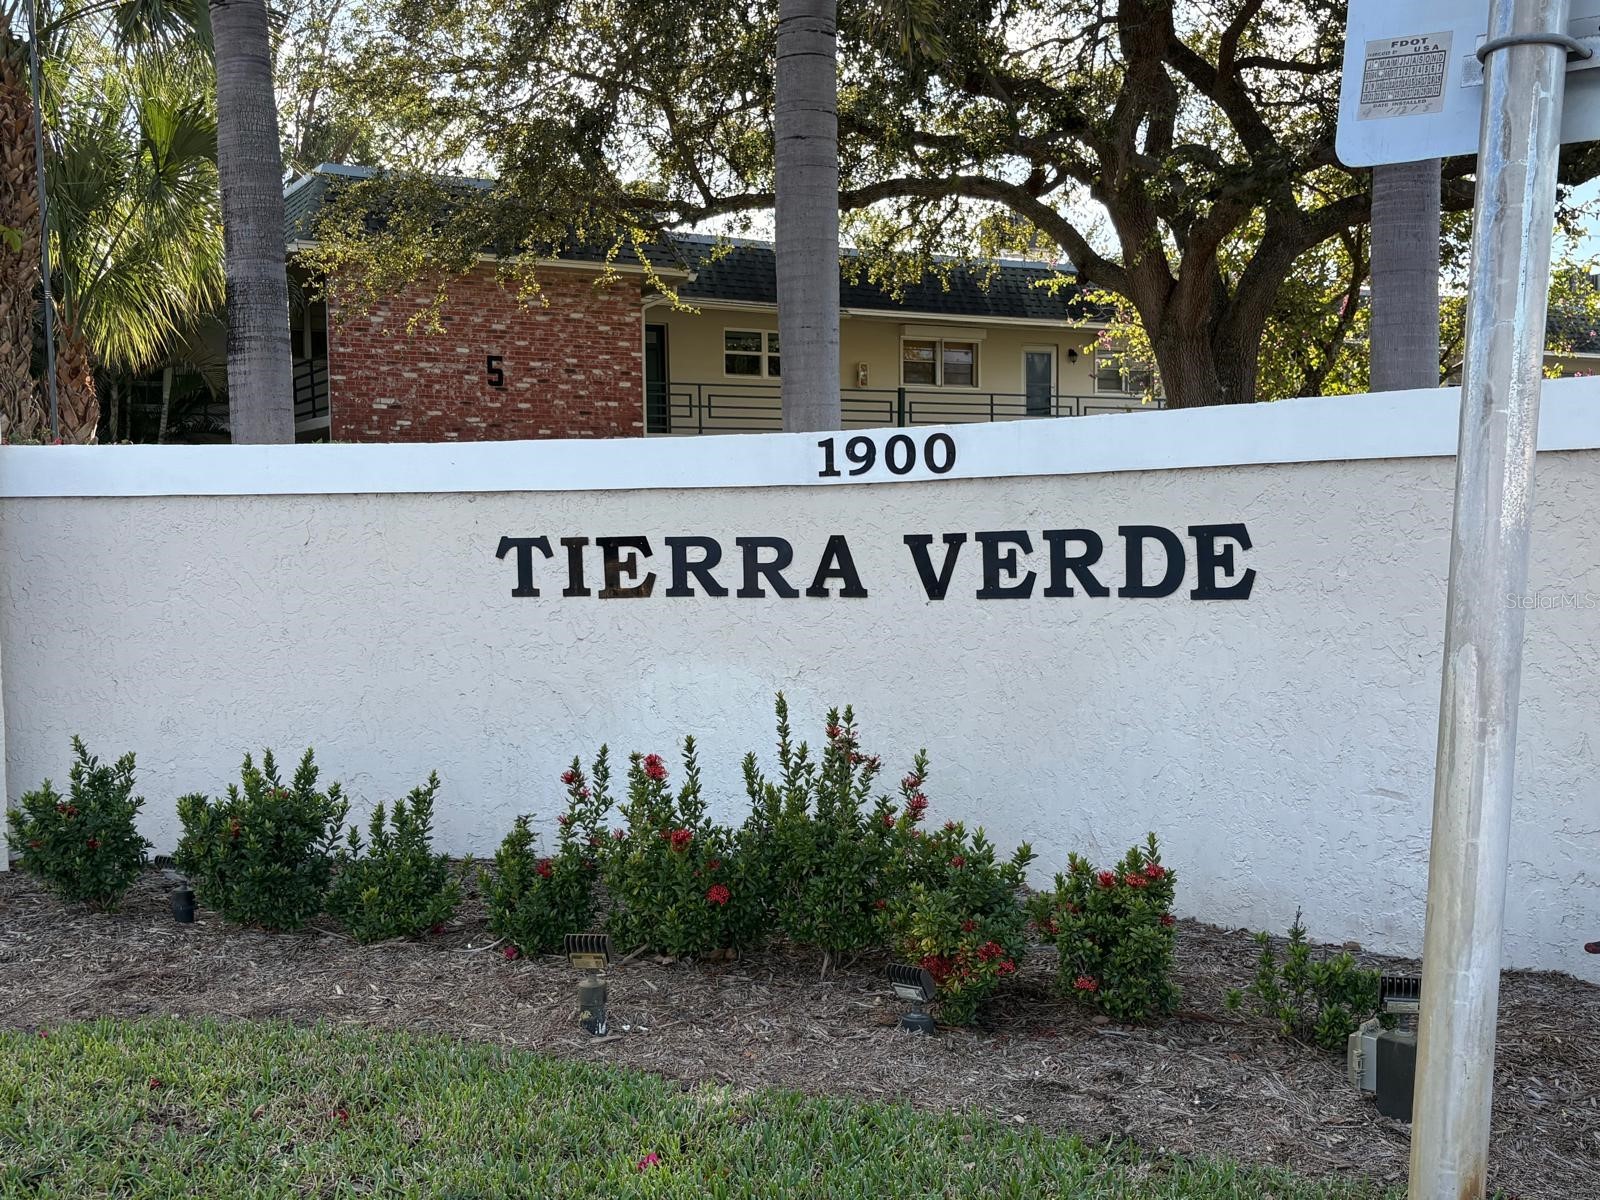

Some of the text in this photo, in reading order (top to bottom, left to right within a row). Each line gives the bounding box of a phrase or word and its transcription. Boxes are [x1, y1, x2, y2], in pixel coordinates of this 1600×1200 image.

[1391, 37, 1429, 48] FDOT
[1414, 44, 1439, 52] USA
[487, 356, 503, 386] 5
[818, 433, 957, 478] 1900
[496, 523, 1257, 601] TIERRA VERDE
